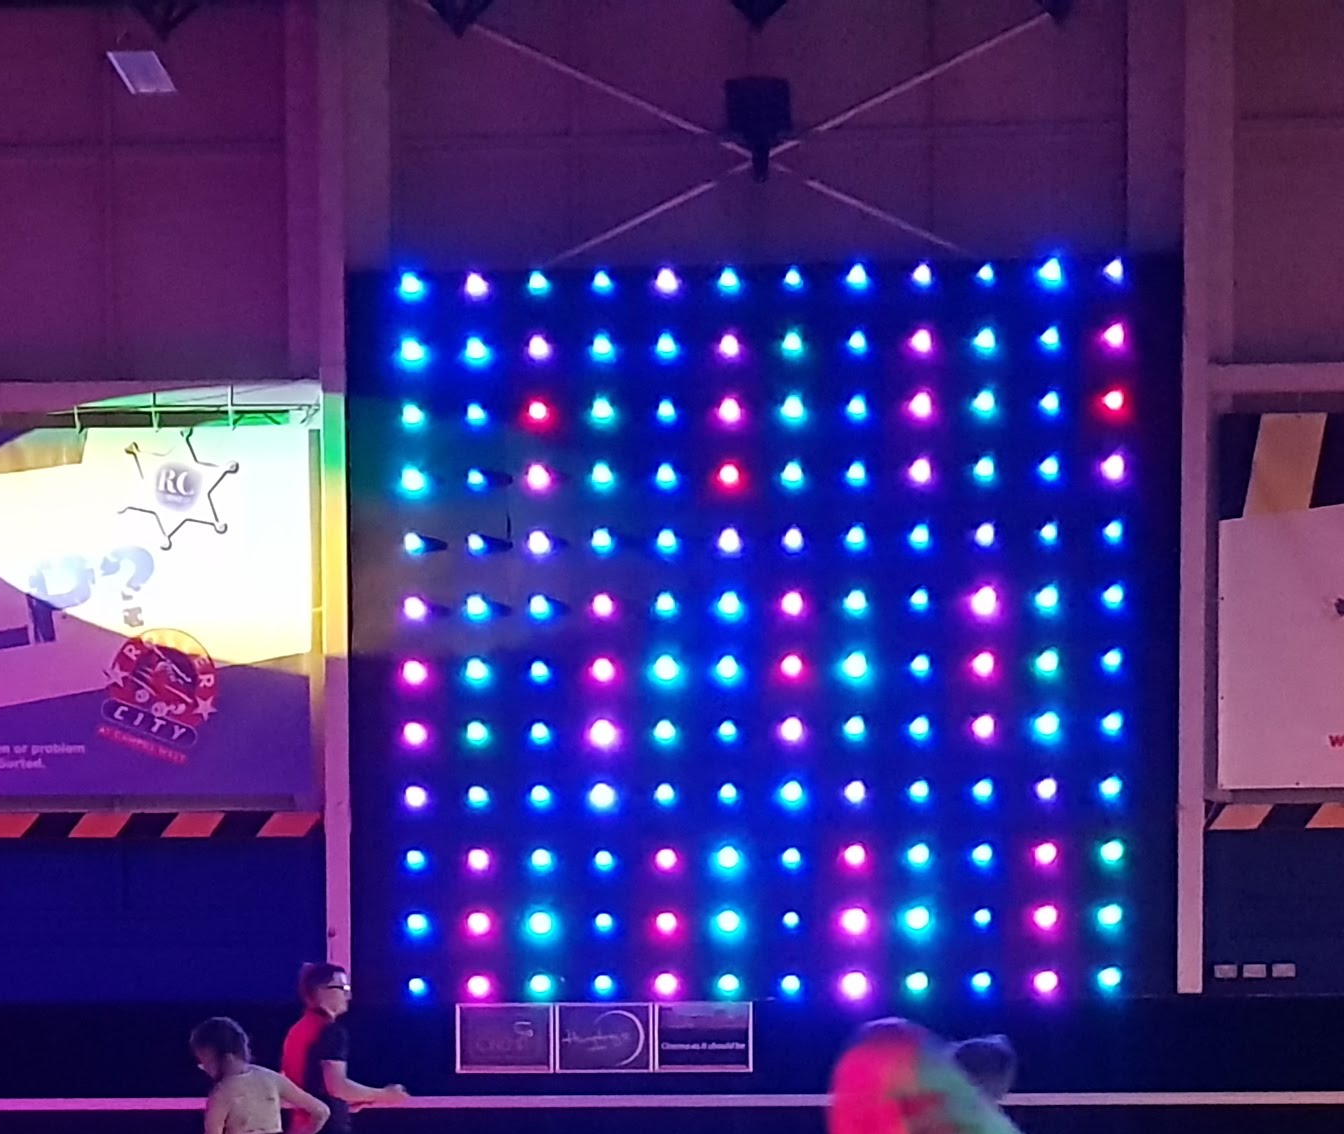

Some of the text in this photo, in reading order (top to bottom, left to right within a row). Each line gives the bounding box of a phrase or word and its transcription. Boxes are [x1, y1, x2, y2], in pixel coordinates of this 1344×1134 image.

[158, 468, 195, 496] RC
[113, 705, 187, 741] CITY
[31, 743, 86, 756] problem
